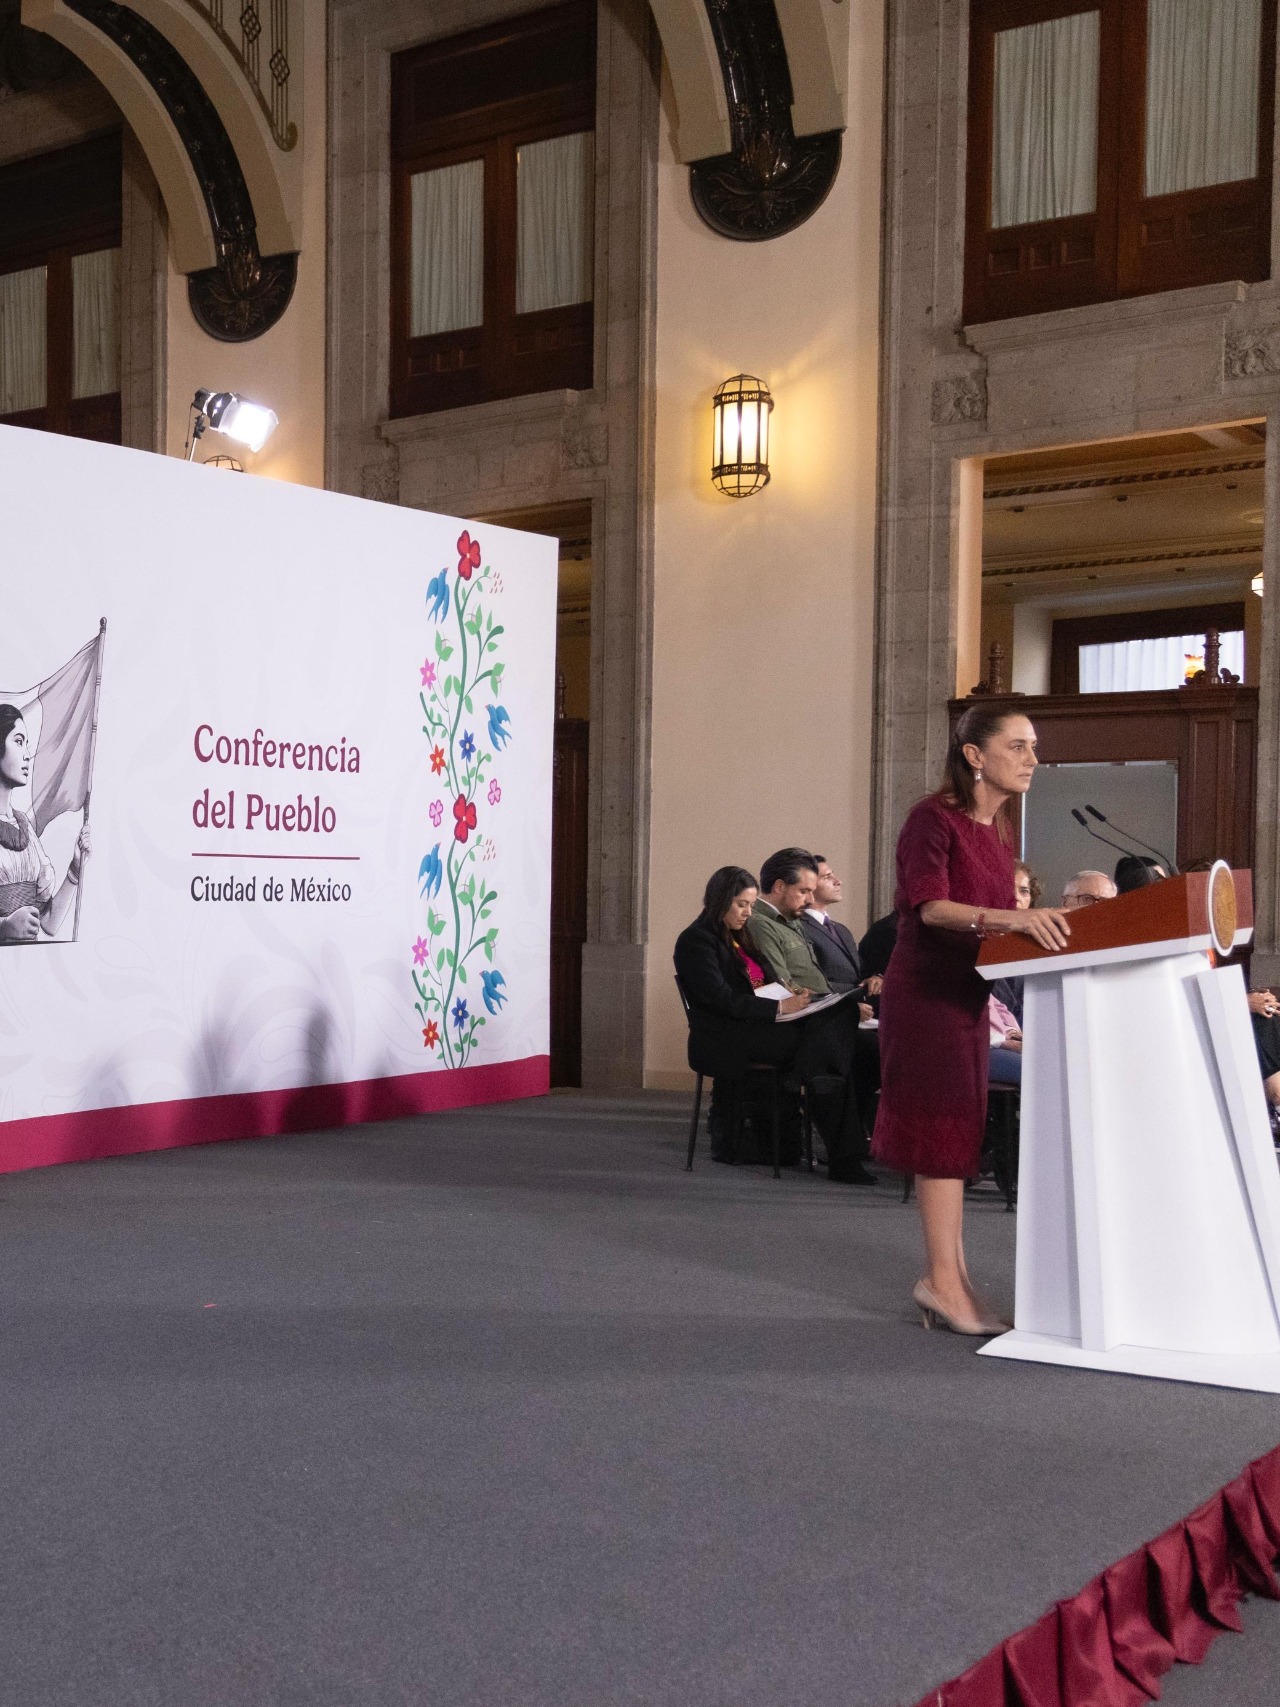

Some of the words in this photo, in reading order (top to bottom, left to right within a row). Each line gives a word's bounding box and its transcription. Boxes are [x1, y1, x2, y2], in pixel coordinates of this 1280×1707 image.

[193, 723, 361, 774] Conferencia
[192, 787, 236, 830] del
[245, 793, 337, 834] Pueblo
[190, 874, 257, 902] Ciudad
[262, 875, 284, 903] de
[289, 876, 352, 903] México
